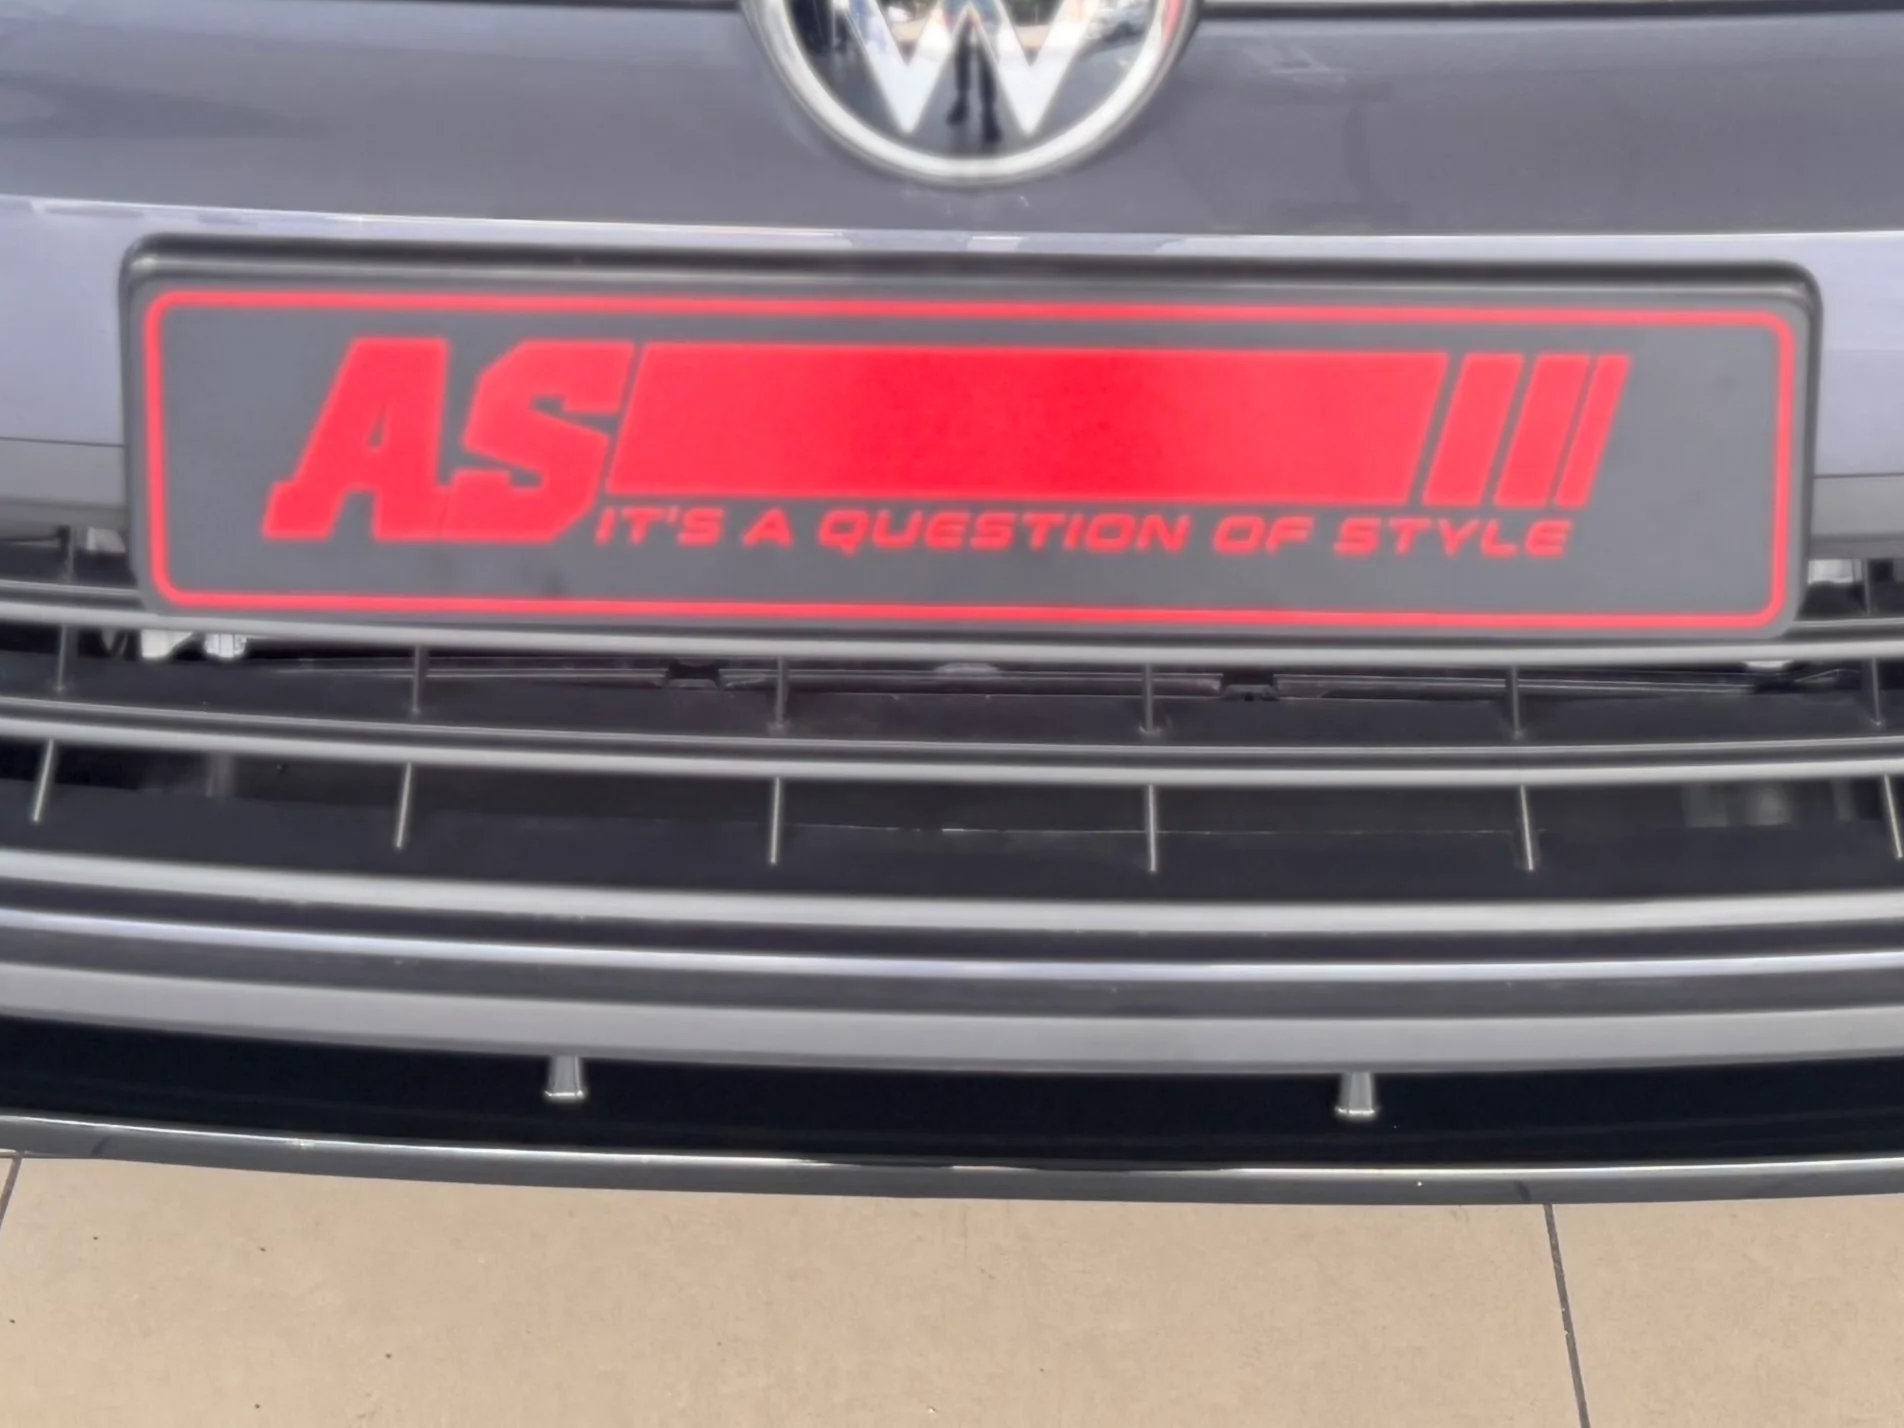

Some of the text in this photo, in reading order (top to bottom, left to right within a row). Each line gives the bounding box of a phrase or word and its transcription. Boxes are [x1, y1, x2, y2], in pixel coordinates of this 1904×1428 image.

[261, 335, 638, 543] AS
[594, 506, 1576, 560] IT'S A QUESTION OF STYLE
